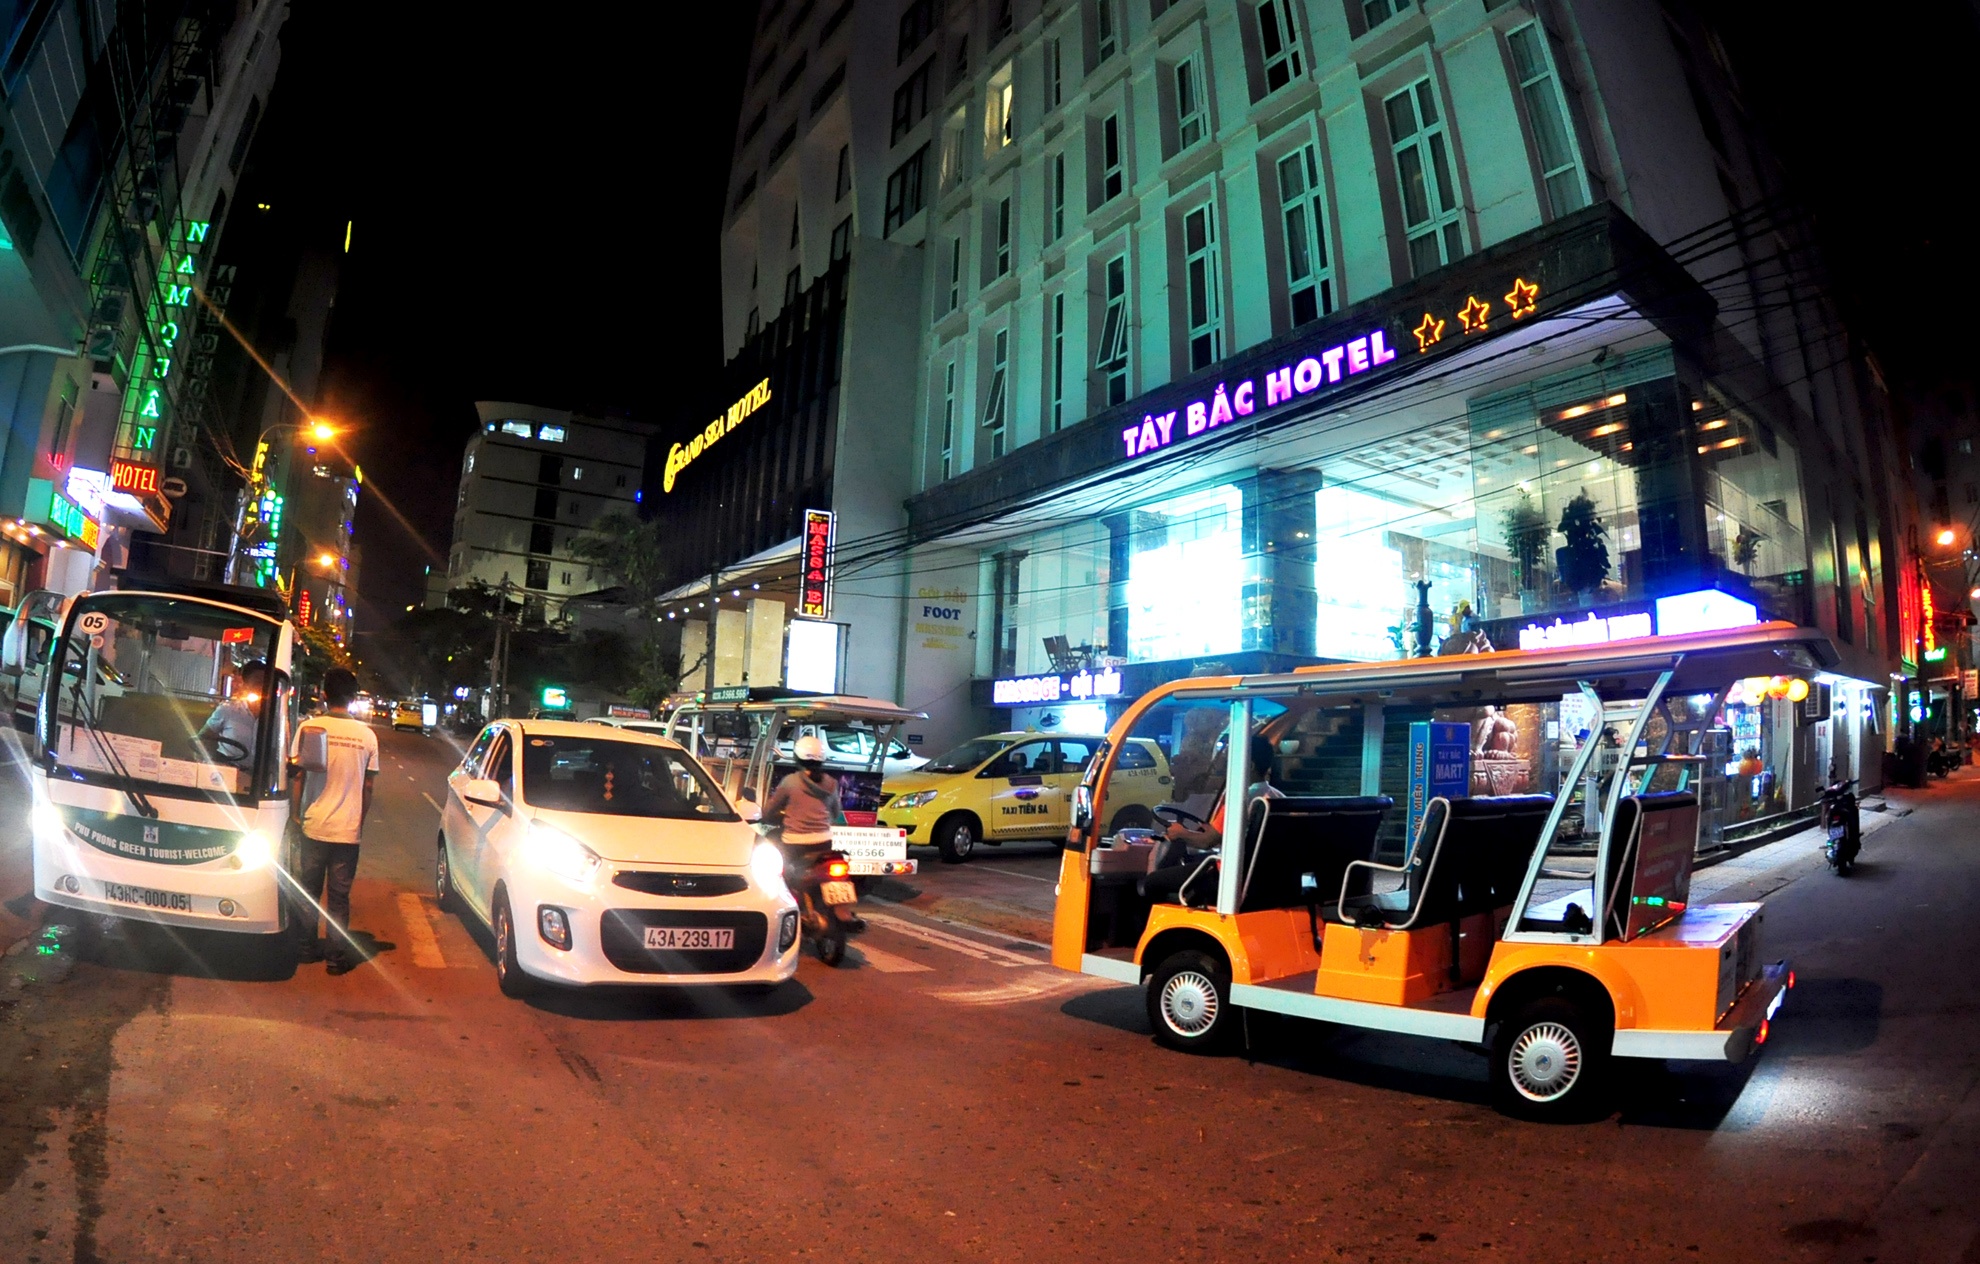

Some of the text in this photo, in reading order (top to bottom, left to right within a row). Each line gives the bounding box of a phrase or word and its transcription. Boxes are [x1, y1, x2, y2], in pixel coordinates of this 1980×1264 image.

[1122, 329, 1396, 458] TÂY BẮC HOTEL
[664, 377, 772, 493] GRAND SEA HOTEL
[114, 463, 158, 492] HOTEL
[807, 522, 828, 603] MASSAE
[83, 616, 104, 629] 05
[804, 603, 823, 616] T4
[923, 606, 961, 620] FOOT
[994, 676, 1060, 703] MASSAGE
[1415, 742, 1424, 779] TRUNG
[1435, 763, 1463, 780] MART
[1002, 806, 1017, 815] TAXI
[1037, 804, 1048, 814] SA
[91, 831, 117, 849] PHONG
[118, 840, 146, 857] GREEN
[110, 884, 187, 911] 43HC-000.05
[647, 929, 732, 948] 43A-239.17
